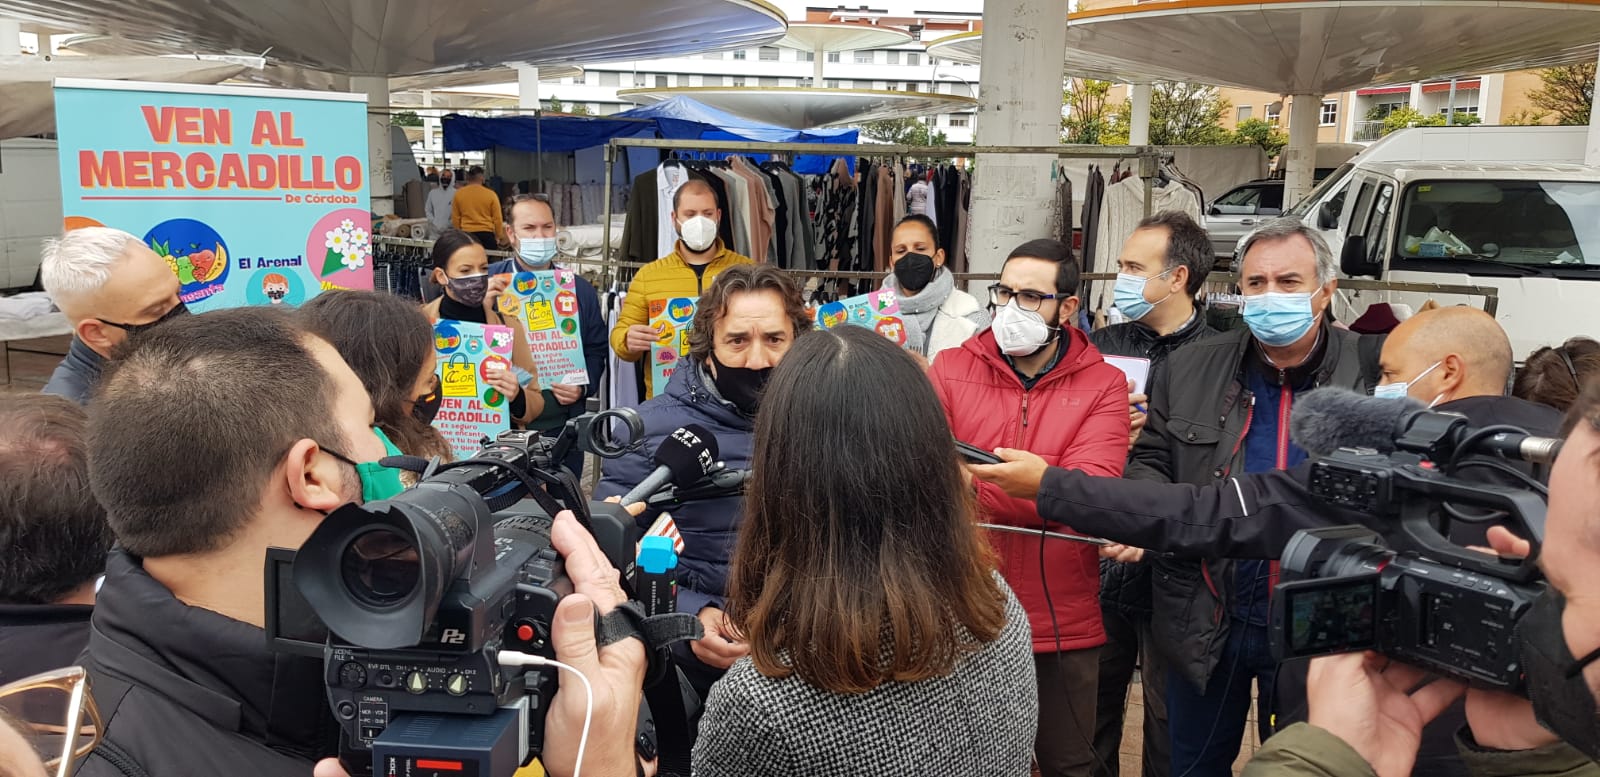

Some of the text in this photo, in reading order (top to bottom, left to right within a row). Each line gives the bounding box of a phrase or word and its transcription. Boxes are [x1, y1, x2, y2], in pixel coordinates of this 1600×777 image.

[141, 105, 306, 148] VEN AL
[78, 150, 363, 192] MERCADILLO
[285, 192, 358, 204] De Córdoba
[238, 255, 302, 270] El Arenal
[528, 330, 563, 342] VEN AL
[468, 400, 483, 410] AL
[440, 628, 466, 644] P2
